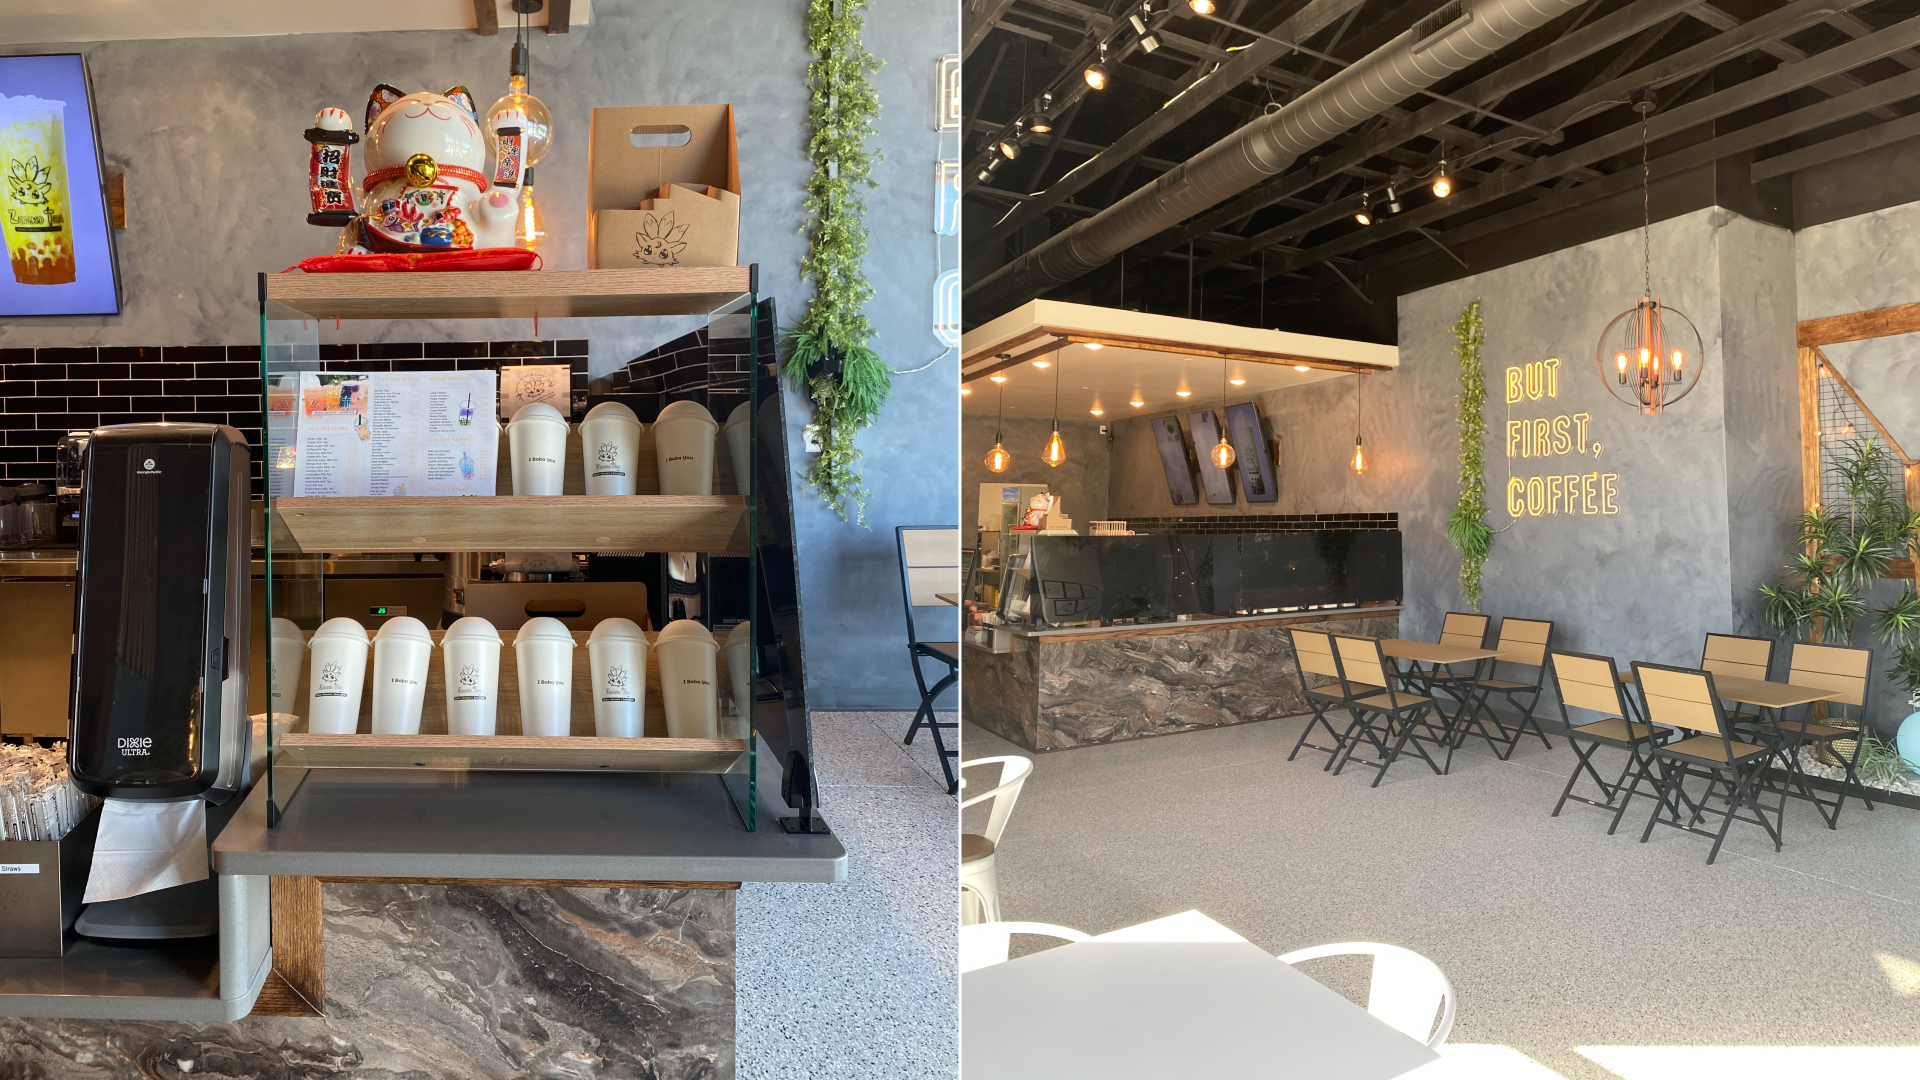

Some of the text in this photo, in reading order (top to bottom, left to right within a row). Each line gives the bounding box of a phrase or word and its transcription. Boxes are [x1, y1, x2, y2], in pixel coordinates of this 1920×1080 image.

[1506, 358, 1561, 404] BUT
[1506, 412, 1604, 460] FIRST,
[1508, 472, 1621, 518] COFFEE
